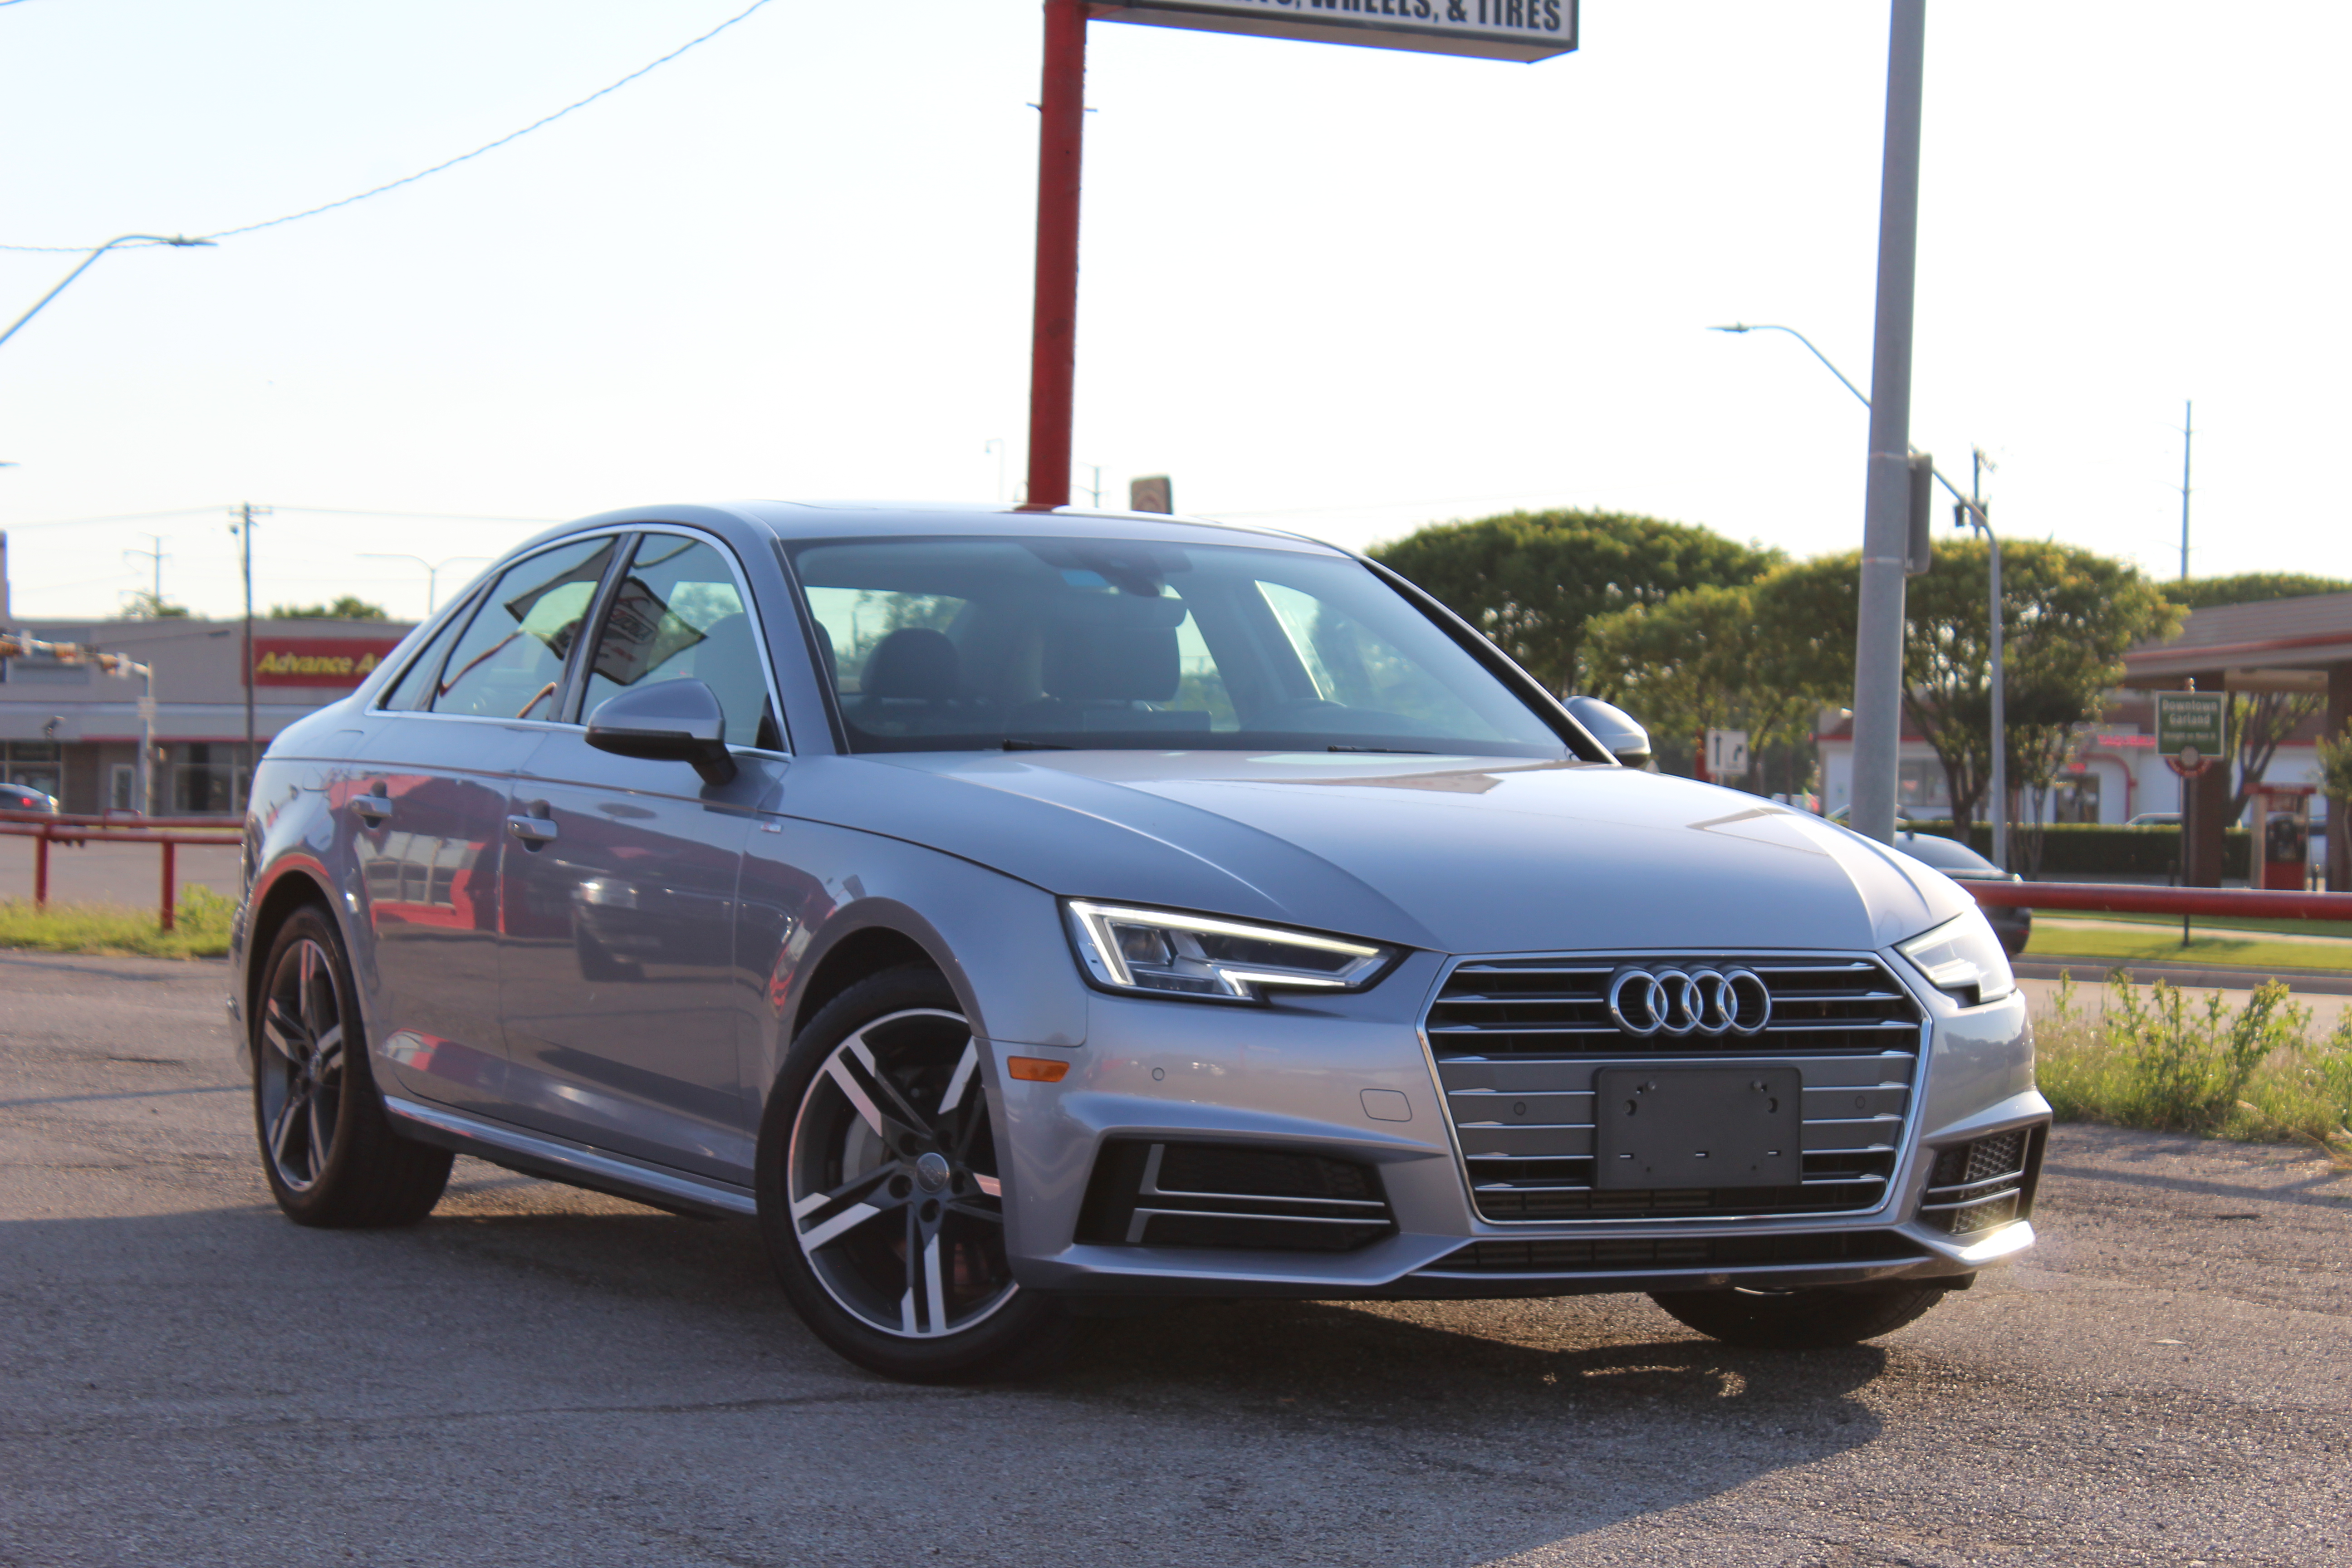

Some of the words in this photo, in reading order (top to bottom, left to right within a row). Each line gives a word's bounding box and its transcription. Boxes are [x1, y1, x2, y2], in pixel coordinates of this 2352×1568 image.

[1311, 0, 1439, 23] ELS,
[1447, 0, 1467, 22] &
[1478, 0, 1561, 31] TIRES
[255, 651, 354, 675] Advance
[354, 652, 384, 674] A
[2162, 700, 2218, 712] Downtown
[2170, 713, 2210, 726] Garland
